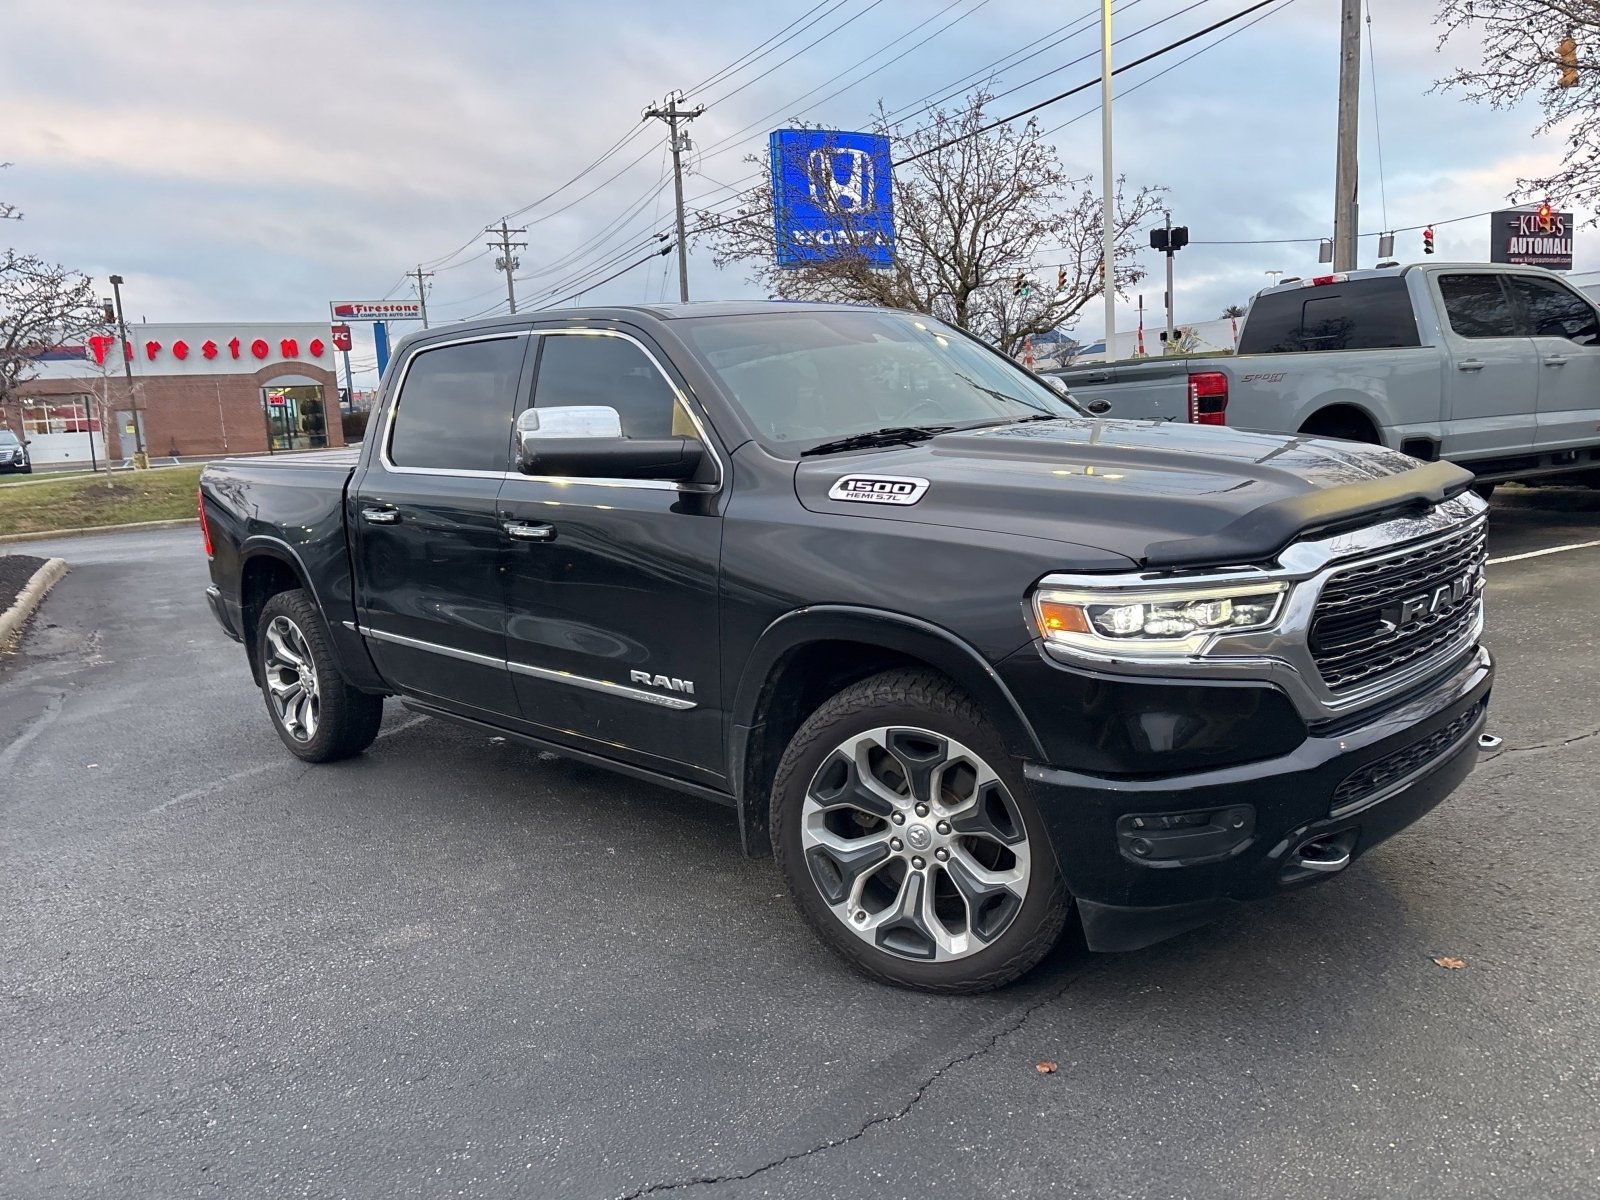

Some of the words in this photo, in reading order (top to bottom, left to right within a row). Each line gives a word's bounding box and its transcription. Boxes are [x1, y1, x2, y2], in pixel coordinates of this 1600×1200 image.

[1508, 237, 1573, 255] AUTOMALL
[353, 304, 420, 313] Firestone
[1241, 372, 1287, 383] SPORT
[847, 481, 912, 495] 1500
[845, 492, 873, 500] HEMI
[875, 494, 901, 502] 5.7L
[630, 669, 695, 694] RAM
